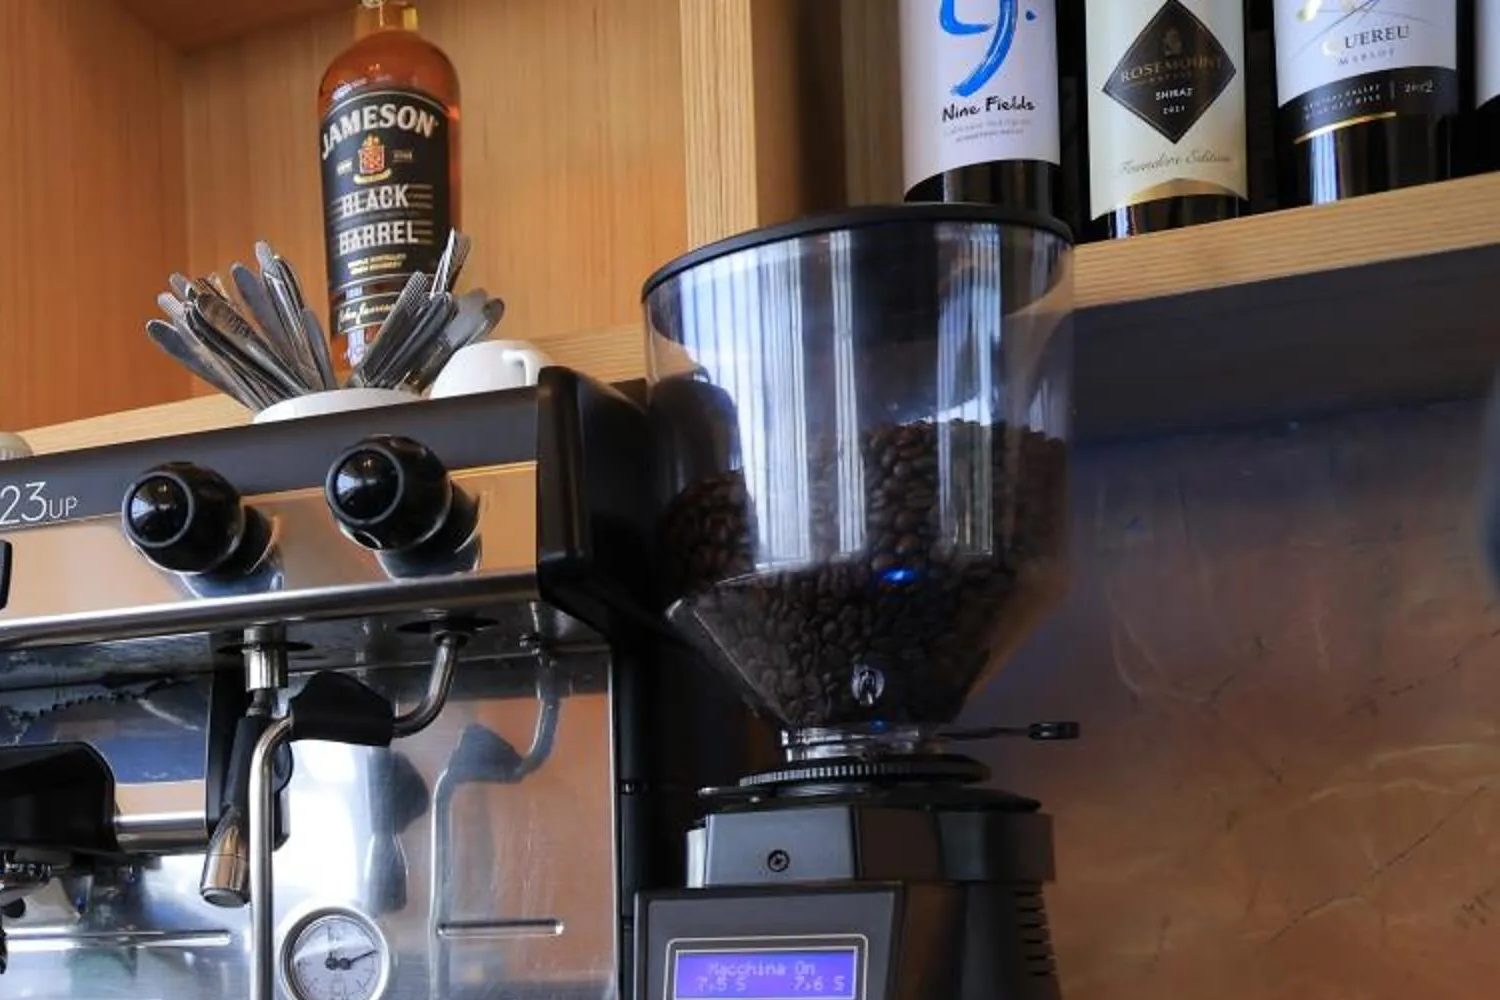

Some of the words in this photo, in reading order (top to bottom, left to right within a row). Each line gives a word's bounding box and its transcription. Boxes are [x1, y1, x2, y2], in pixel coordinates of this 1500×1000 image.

[941, 103, 981, 122] Nine
[985, 95, 1036, 112] Fields
[322, 103, 435, 160] JAMESON
[341, 183, 409, 218] BLACK
[339, 220, 419, 256] BARREL
